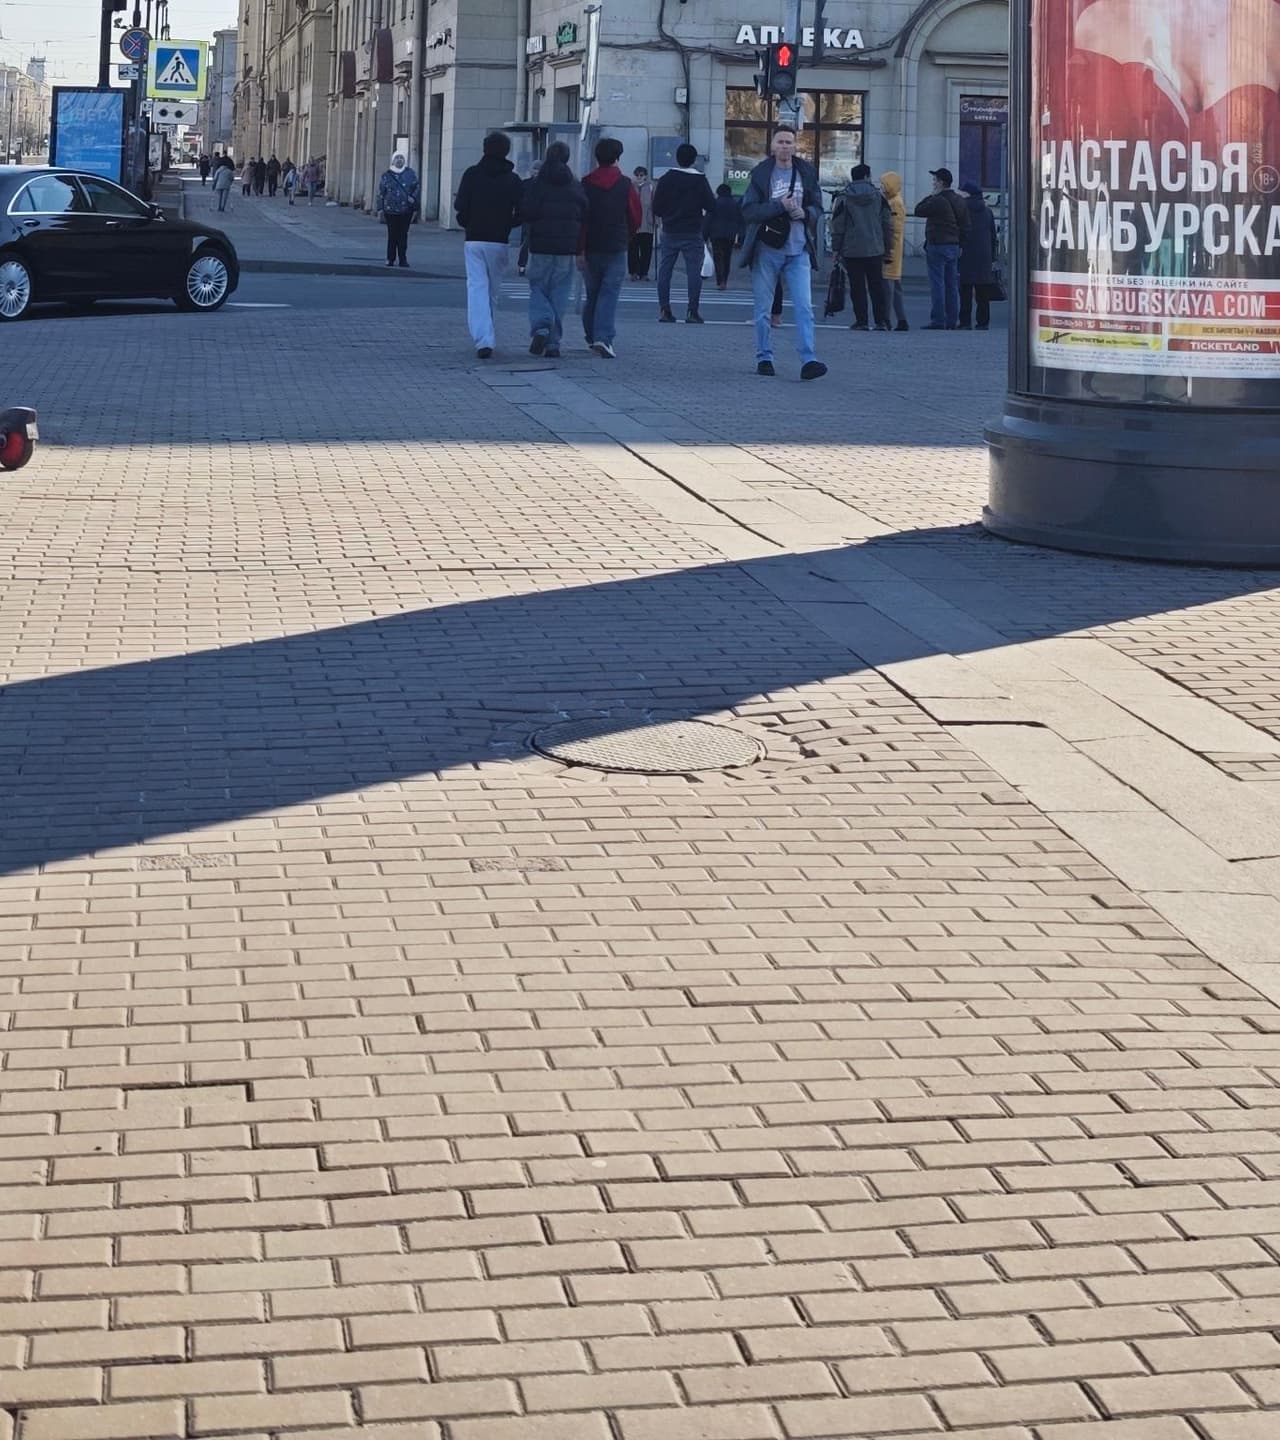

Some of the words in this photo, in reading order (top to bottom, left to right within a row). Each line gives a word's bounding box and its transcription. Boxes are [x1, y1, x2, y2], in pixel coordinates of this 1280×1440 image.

[1040, 139, 1248, 193] НАСТАСЬЯ
[1258, 172, 1275, 187] 18+
[1127, 277, 1144, 286] БЕЗ
[1199, 280, 1213, 288] НА
[1216, 279, 1249, 289] САЙТЕ
[1075, 288, 1266, 318] SAMBURSKAYA.COM
[1190, 341, 1260, 352] TICKETLAND
